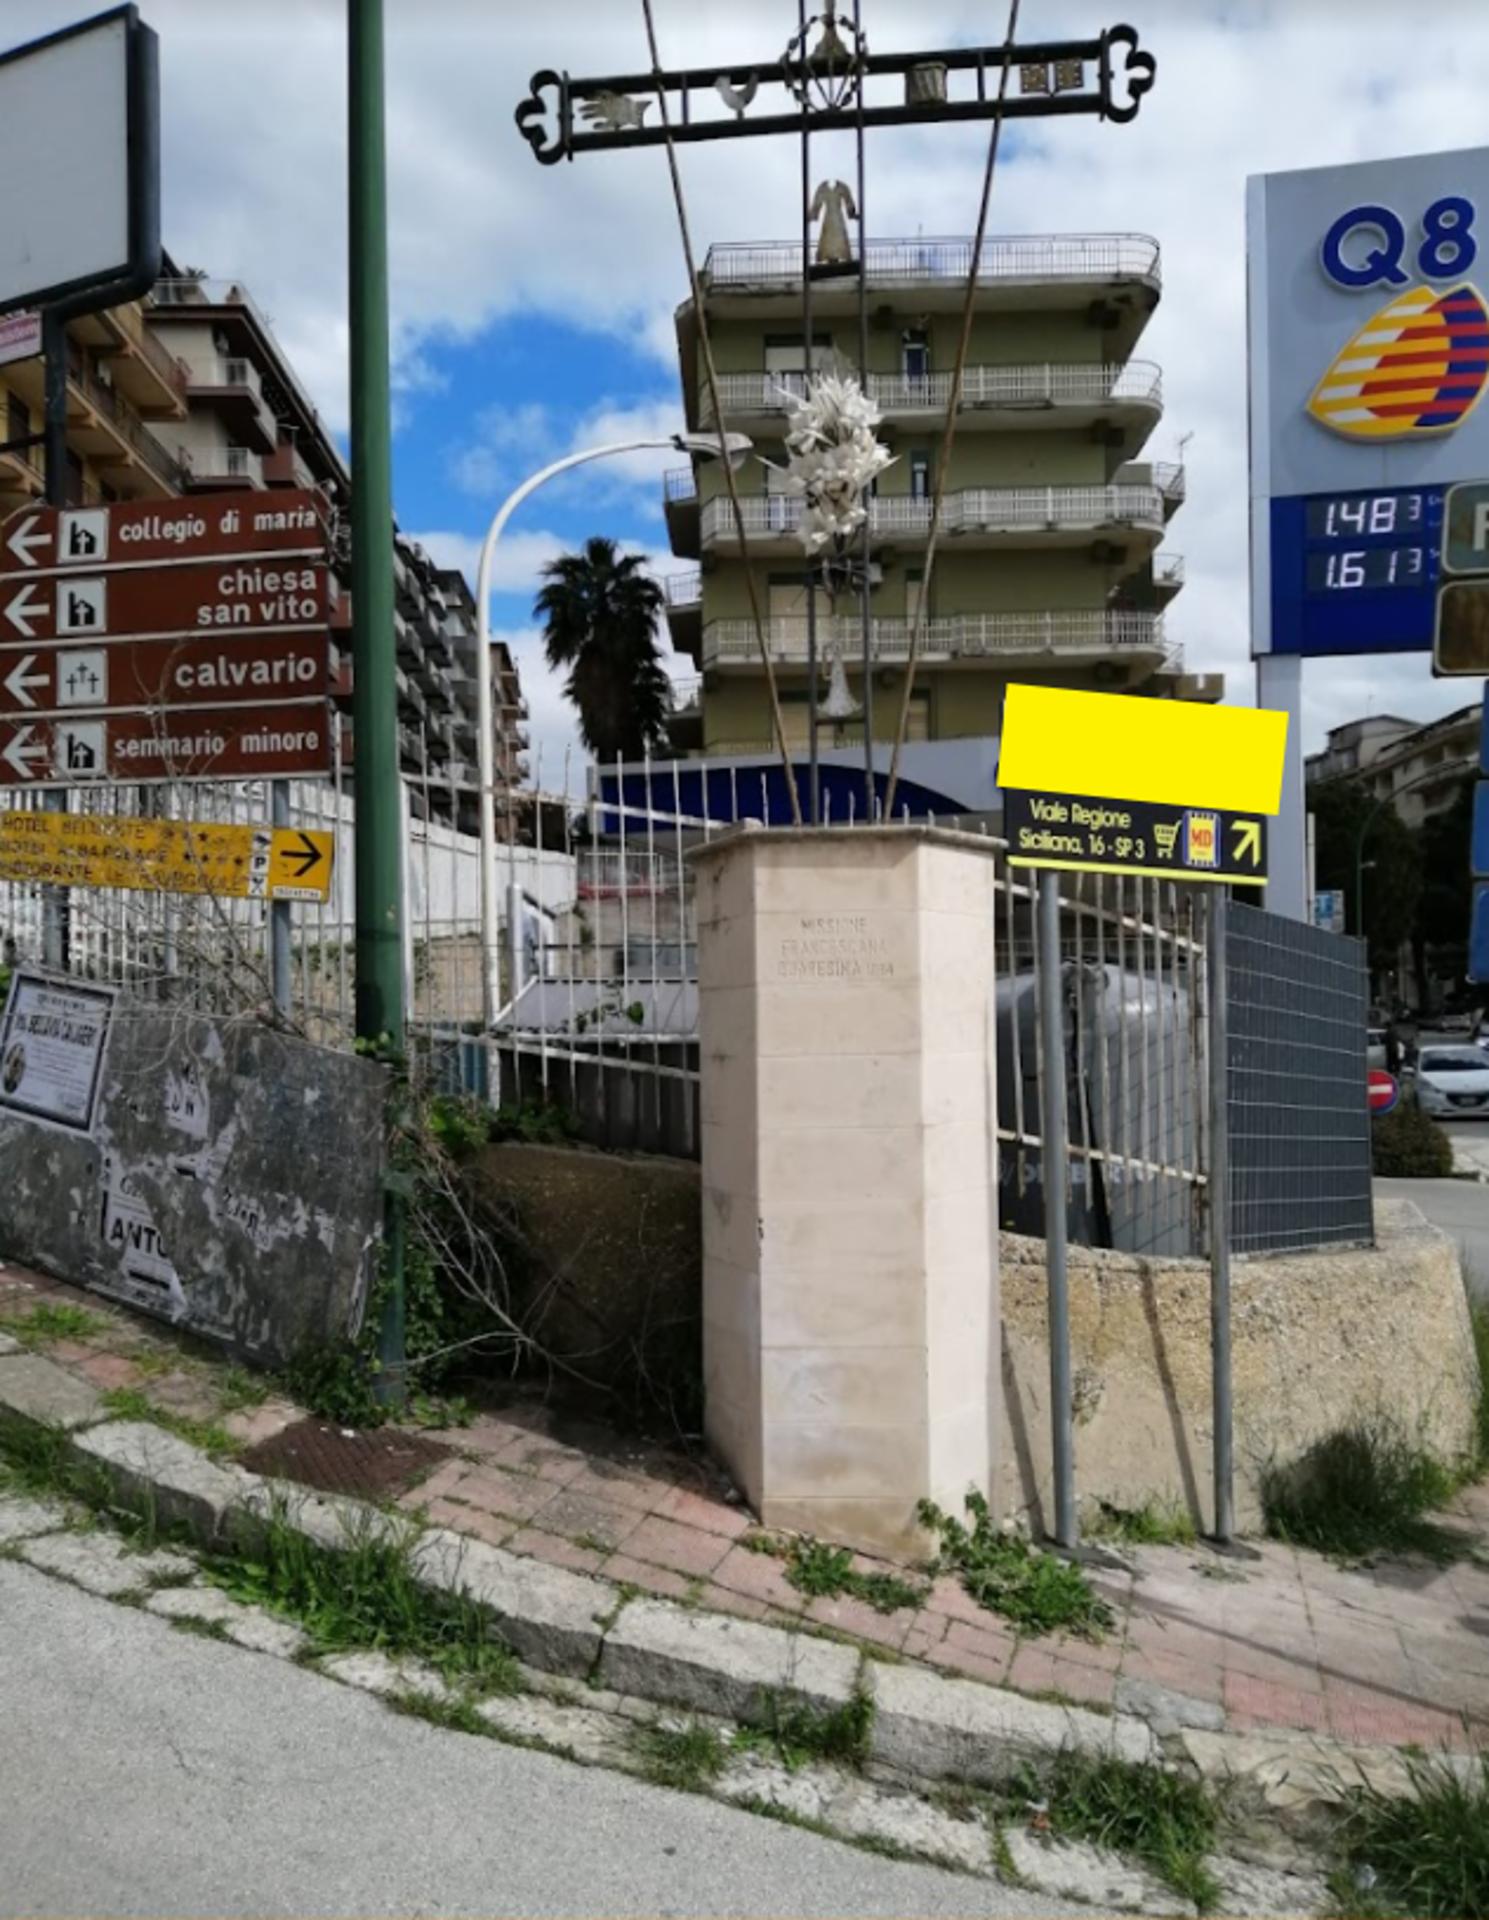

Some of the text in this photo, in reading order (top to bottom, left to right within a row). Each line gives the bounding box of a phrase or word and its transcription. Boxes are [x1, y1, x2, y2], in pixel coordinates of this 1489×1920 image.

[1320, 195, 1478, 288] Q8
[119, 505, 317, 543] collegio di maria
[218, 568, 317, 595] chiesa
[197, 595, 318, 625] san vito
[175, 652, 317, 687] calvario
[114, 726, 319, 758] seminario minore
[3, 816, 49, 833] HOTEL
[1029, 798, 1132, 831] Viale Regione
[1088, 833, 1105, 856] 16
[1115, 836, 1134, 858] SP
[1135, 838, 1146, 860] 3
